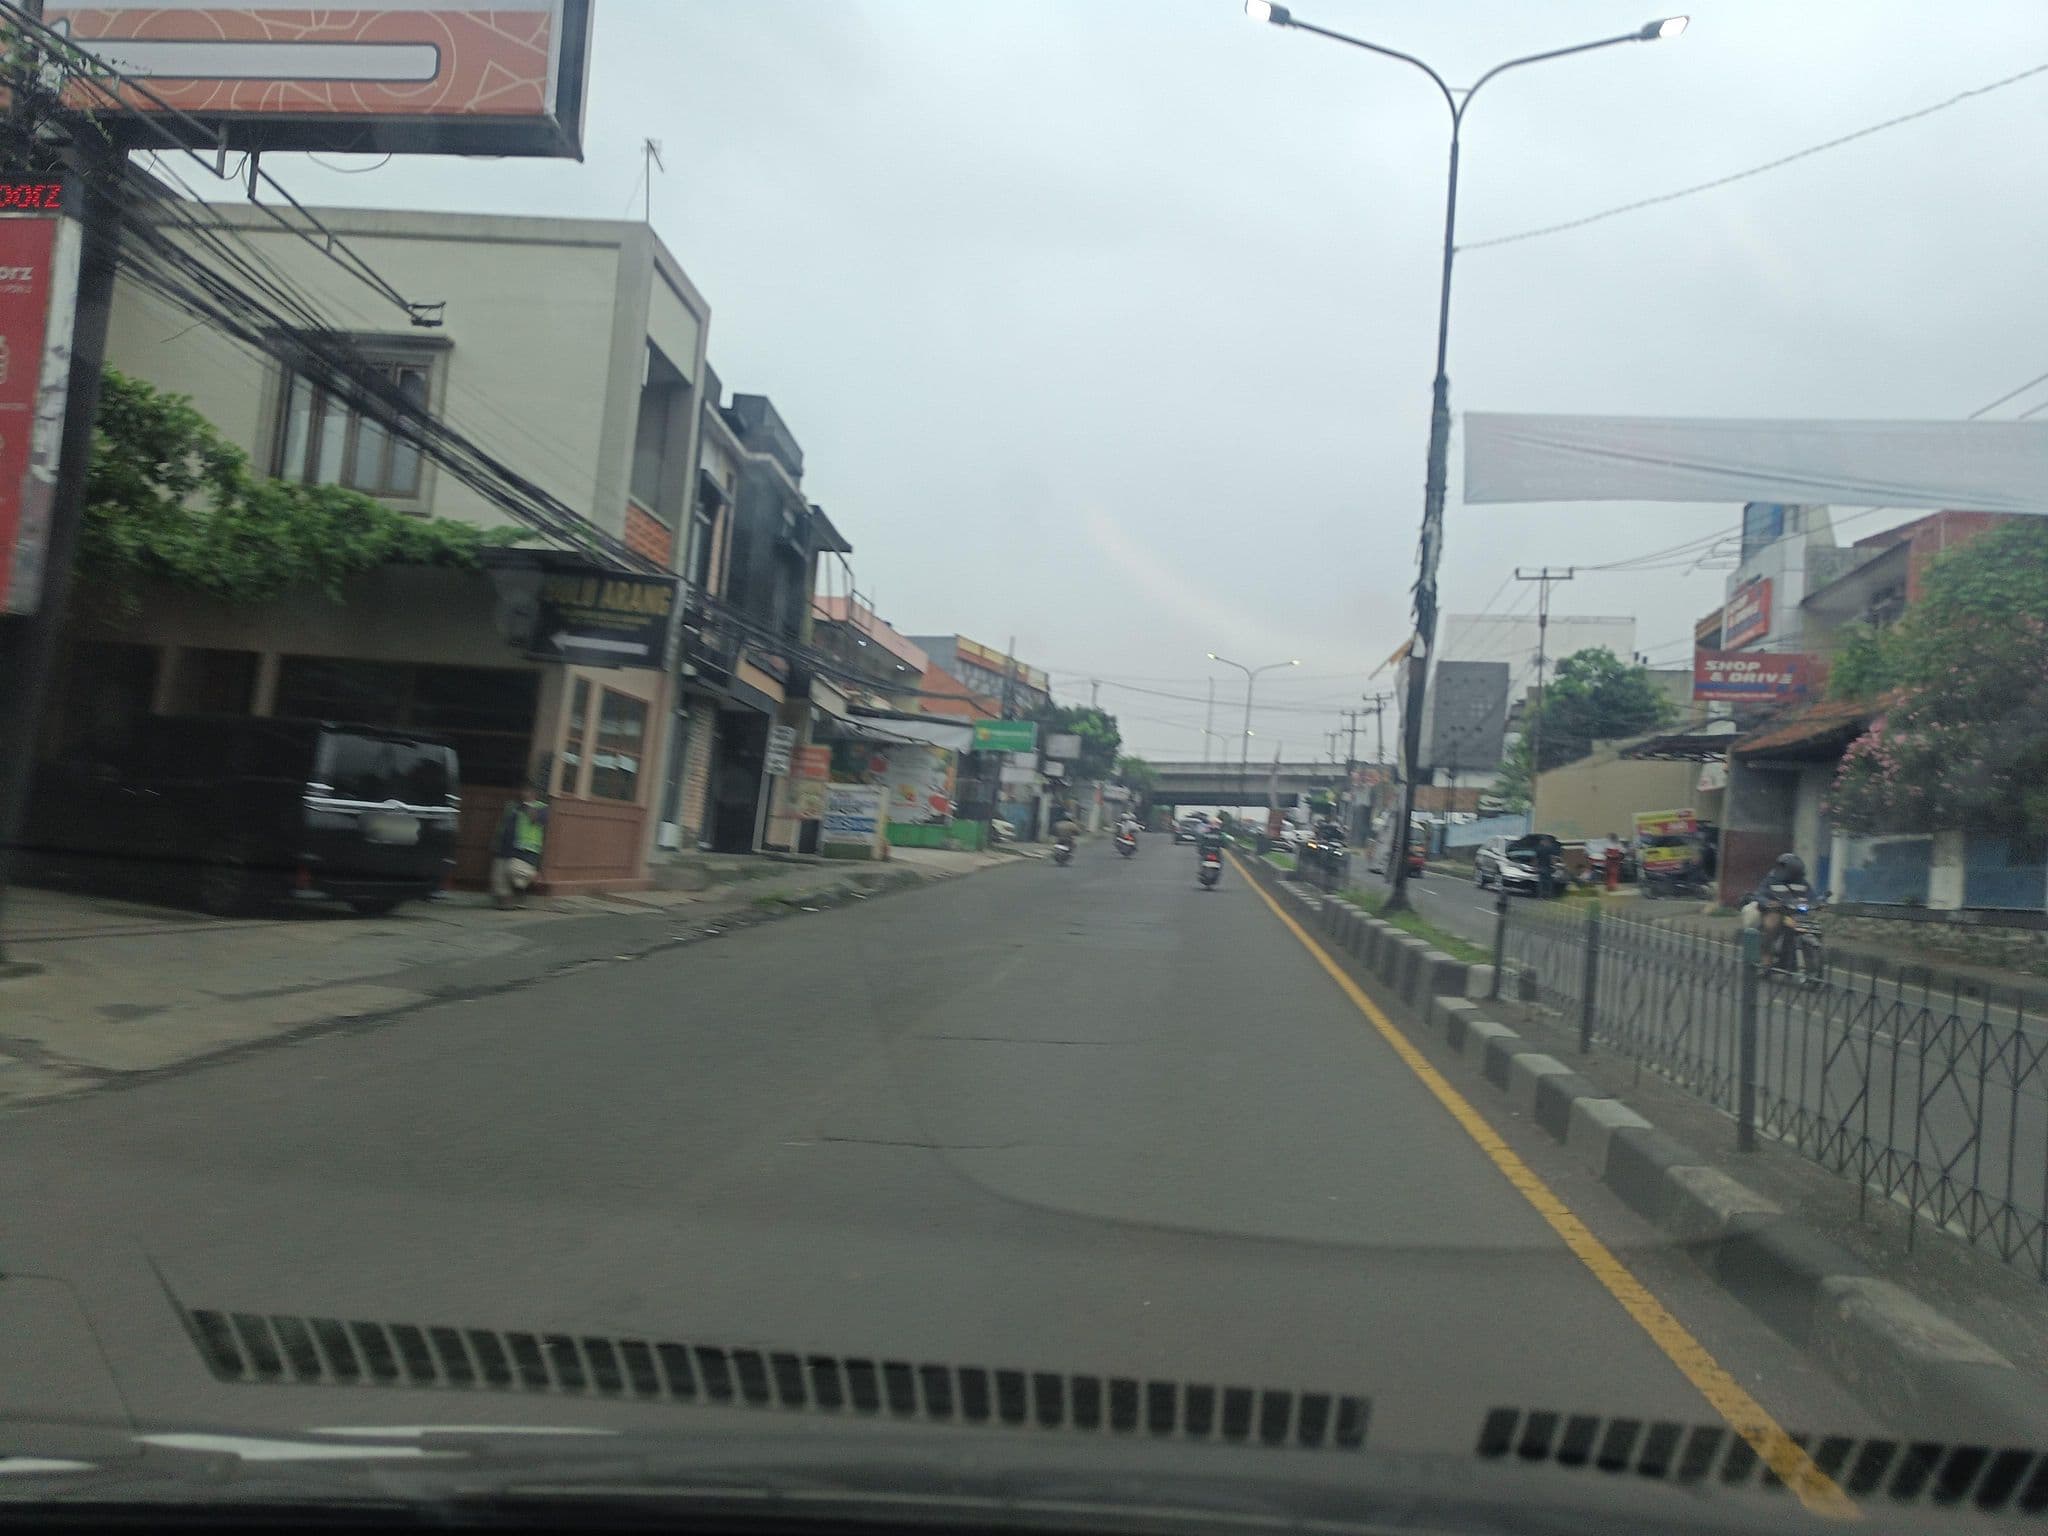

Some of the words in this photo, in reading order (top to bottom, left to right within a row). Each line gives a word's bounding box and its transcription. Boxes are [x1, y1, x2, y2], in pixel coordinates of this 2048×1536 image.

[1704, 660, 1761, 672] SHOP
[1710, 671, 1724, 682] &
[1728, 672, 1793, 684] DRIVE
